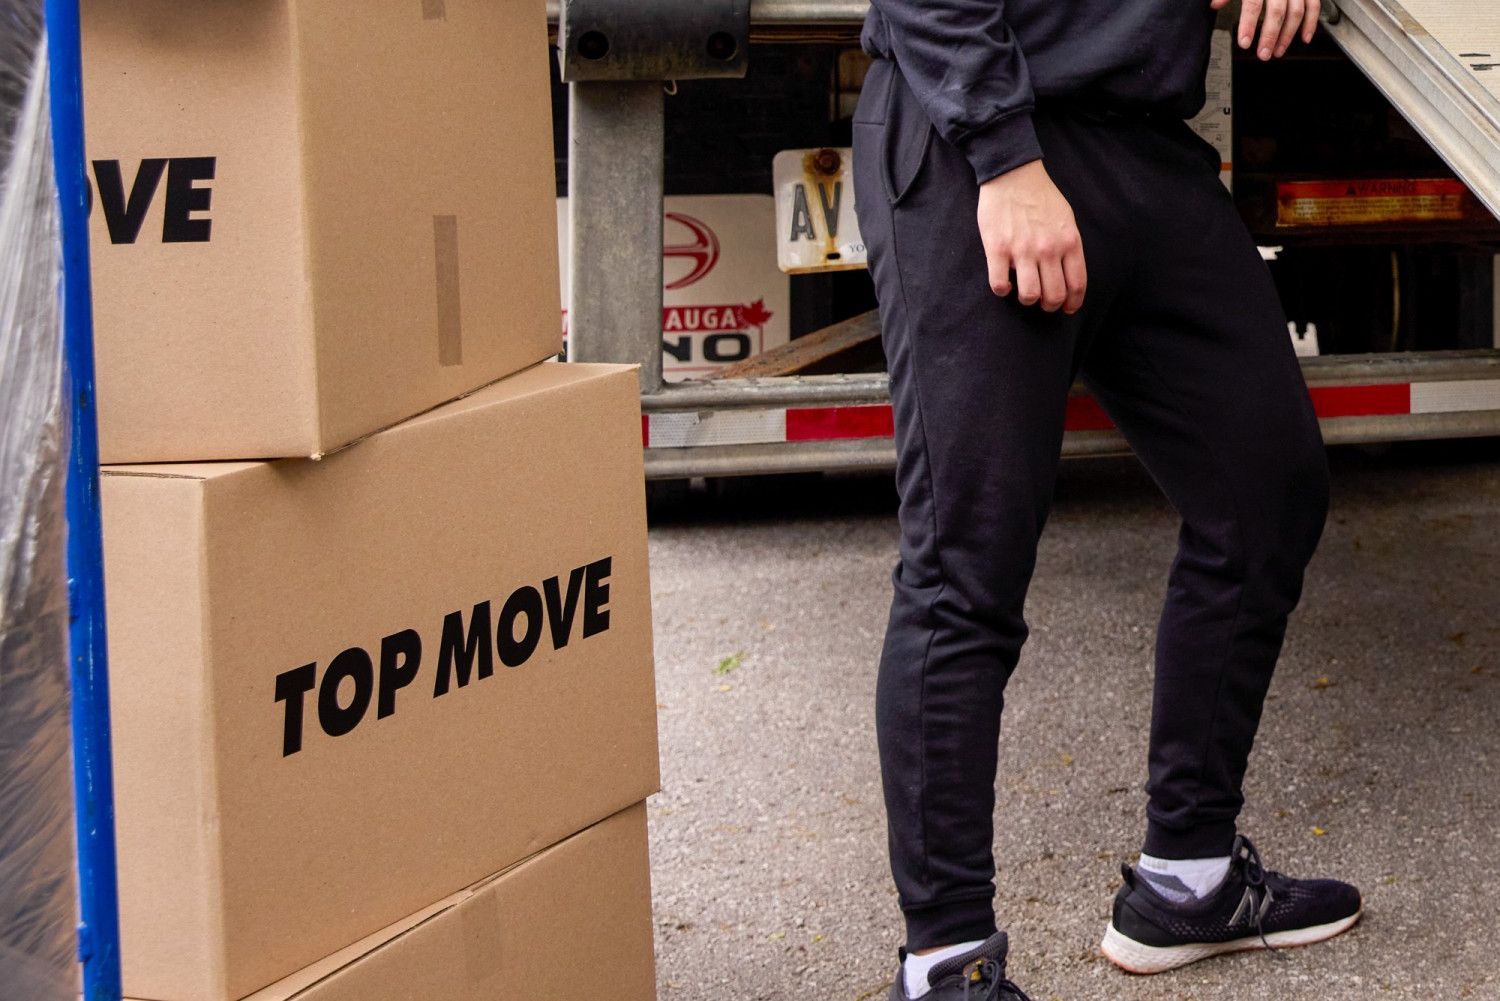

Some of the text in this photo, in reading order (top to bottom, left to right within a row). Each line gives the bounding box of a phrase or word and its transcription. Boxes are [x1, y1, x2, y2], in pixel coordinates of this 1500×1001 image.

[87, 157, 216, 245] VE
[790, 181, 842, 241] AV
[1357, 183, 1417, 195] WARNING
[665, 308, 738, 329] AUGA
[274, 556, 612, 758] TOP MOVE
